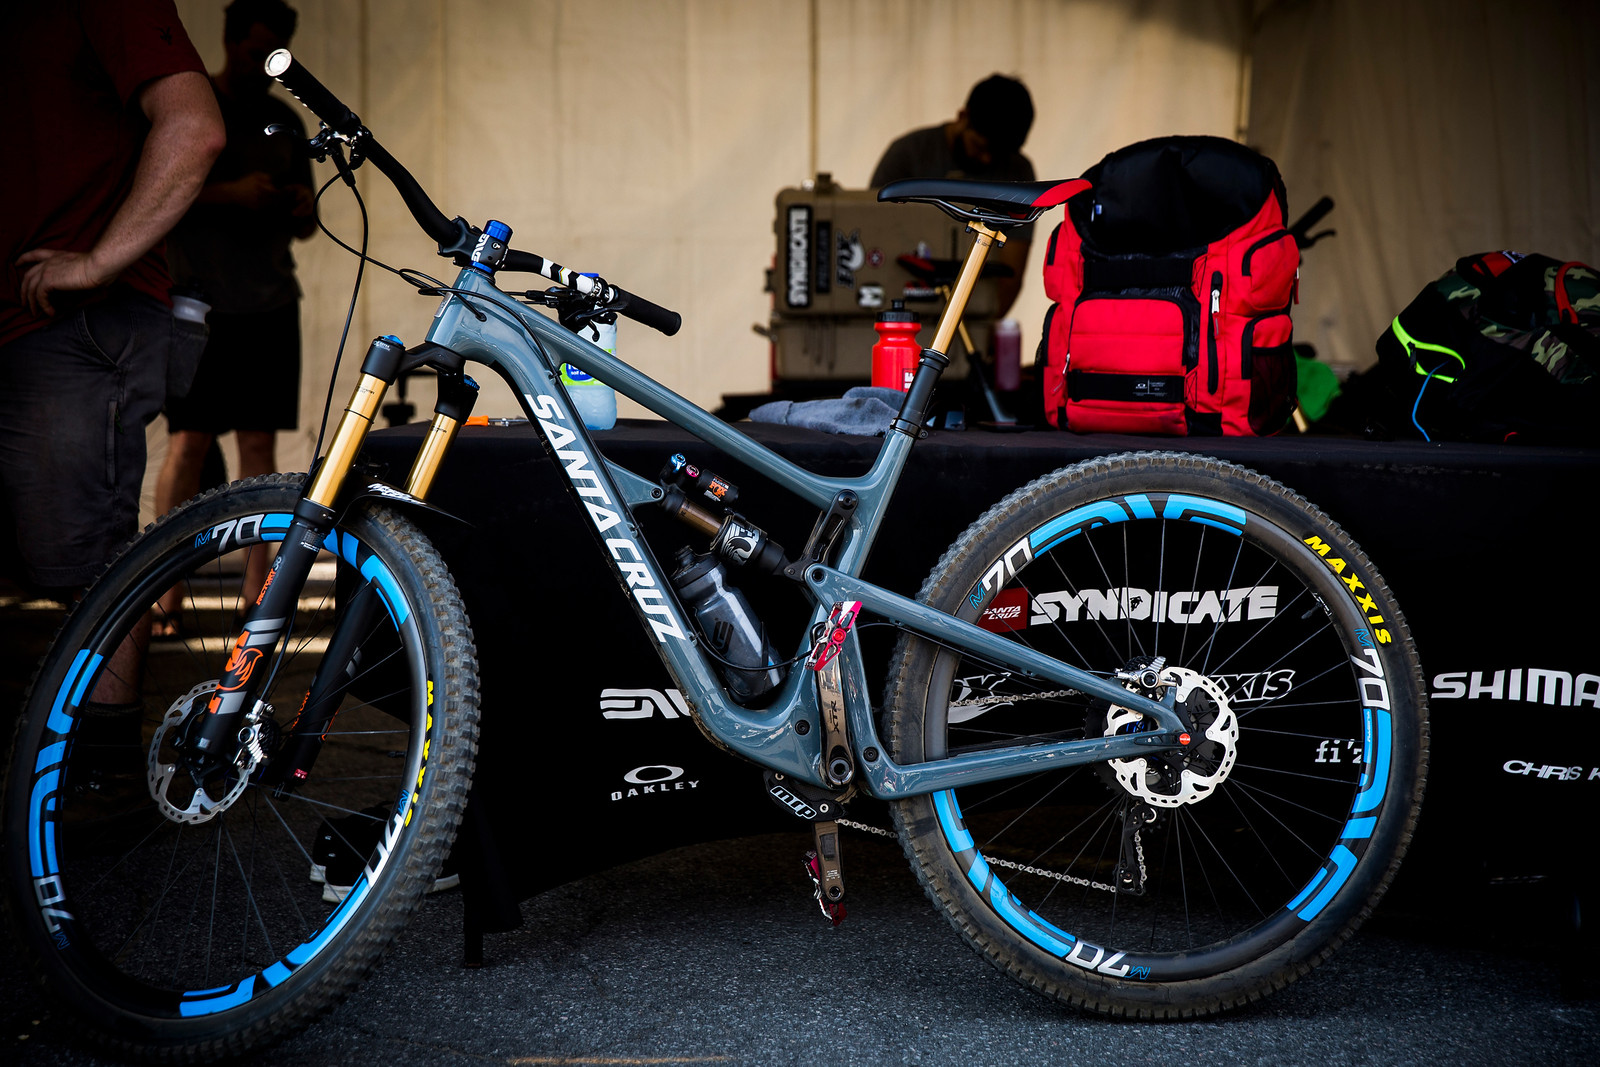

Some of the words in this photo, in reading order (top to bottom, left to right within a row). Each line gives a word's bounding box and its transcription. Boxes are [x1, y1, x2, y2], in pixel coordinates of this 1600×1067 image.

[525, 393, 622, 533] SANTA
[605, 538, 687, 643] CRUZ
[1031, 586, 1279, 626] SYNDICATE
[1304, 535, 1393, 645] MAXXIS
[983, 605, 1022, 616] SANTA
[988, 611, 1021, 620] CRUZ
[404, 680, 435, 827] MAXXIS
[1502, 760, 1583, 781] CHRIS
[611, 780, 700, 801] OAKLEY
[769, 785, 818, 820] mrp
